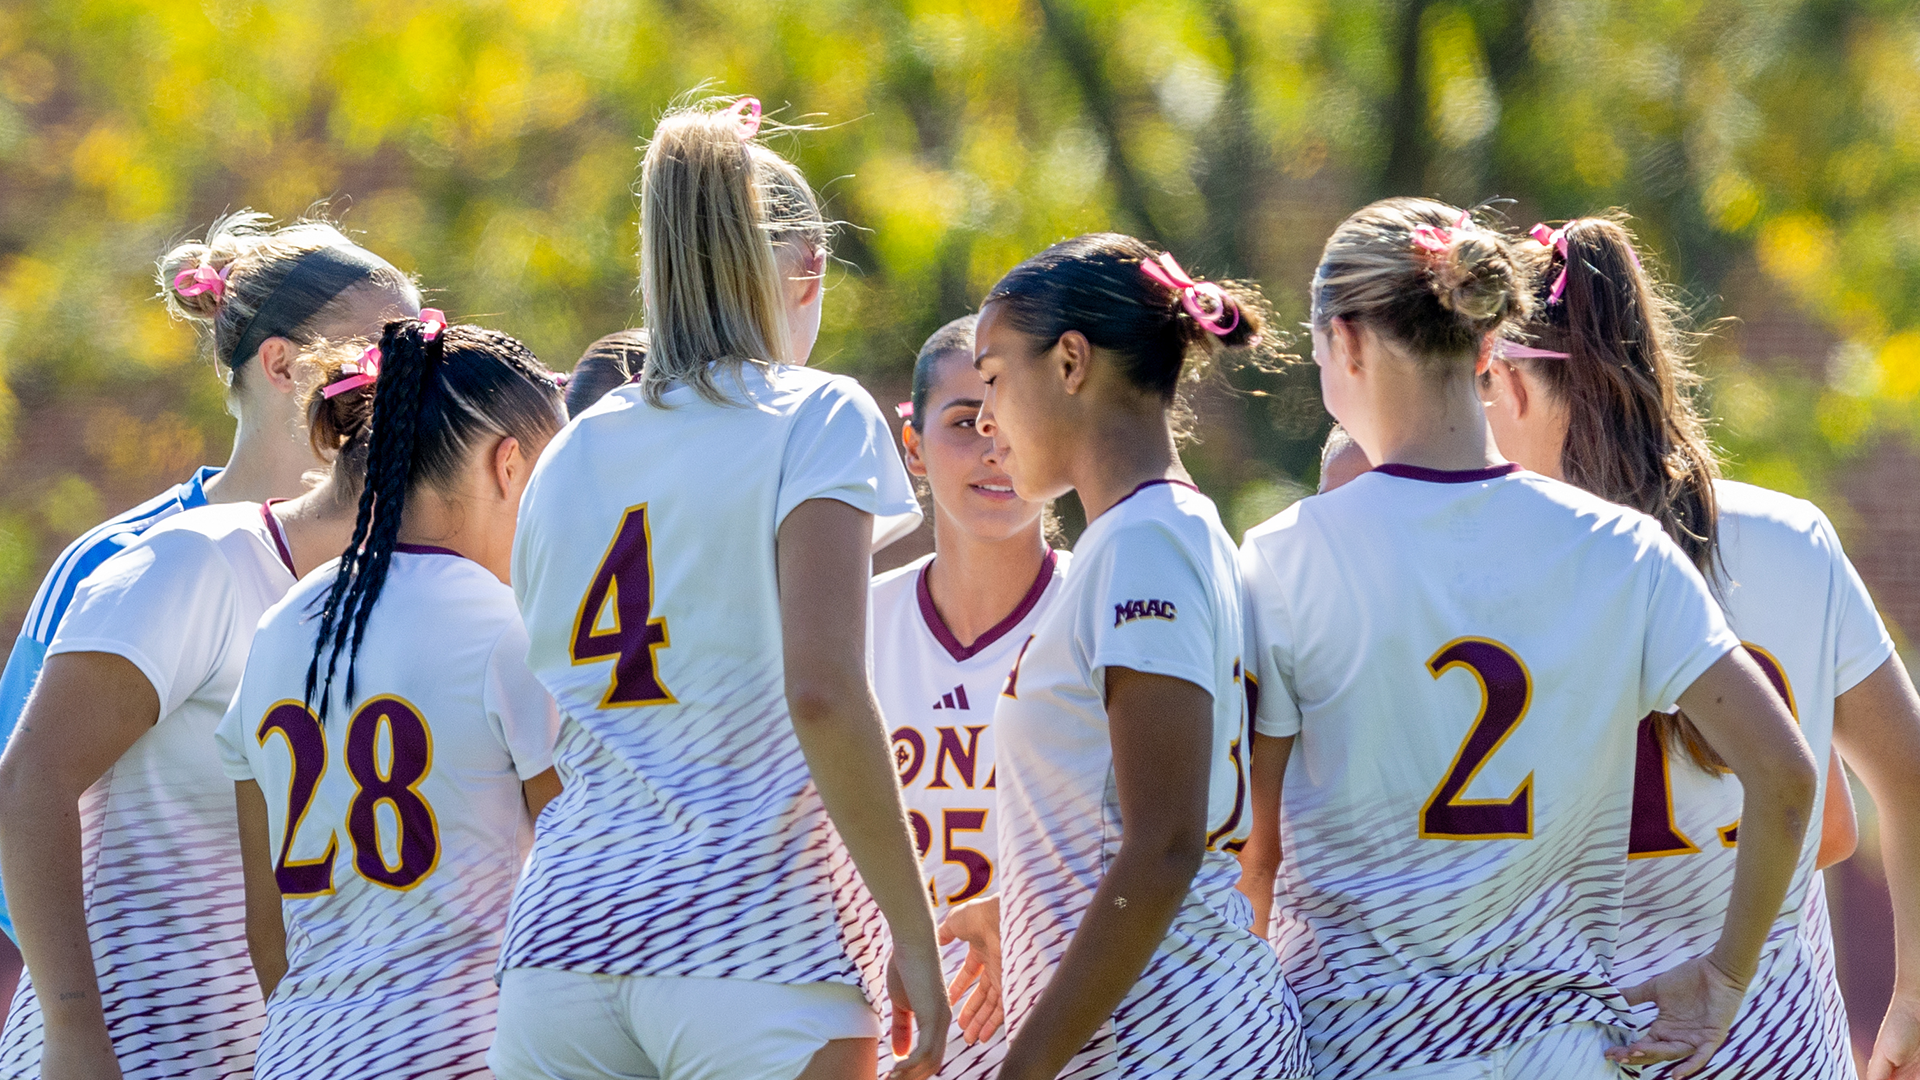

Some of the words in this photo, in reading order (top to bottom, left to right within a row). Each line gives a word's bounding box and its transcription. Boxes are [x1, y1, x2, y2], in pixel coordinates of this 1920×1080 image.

[569, 502, 679, 710] 4
[1114, 599, 1178, 630] MAAC
[255, 693, 441, 900] 28
[1418, 635, 1534, 841] 2
